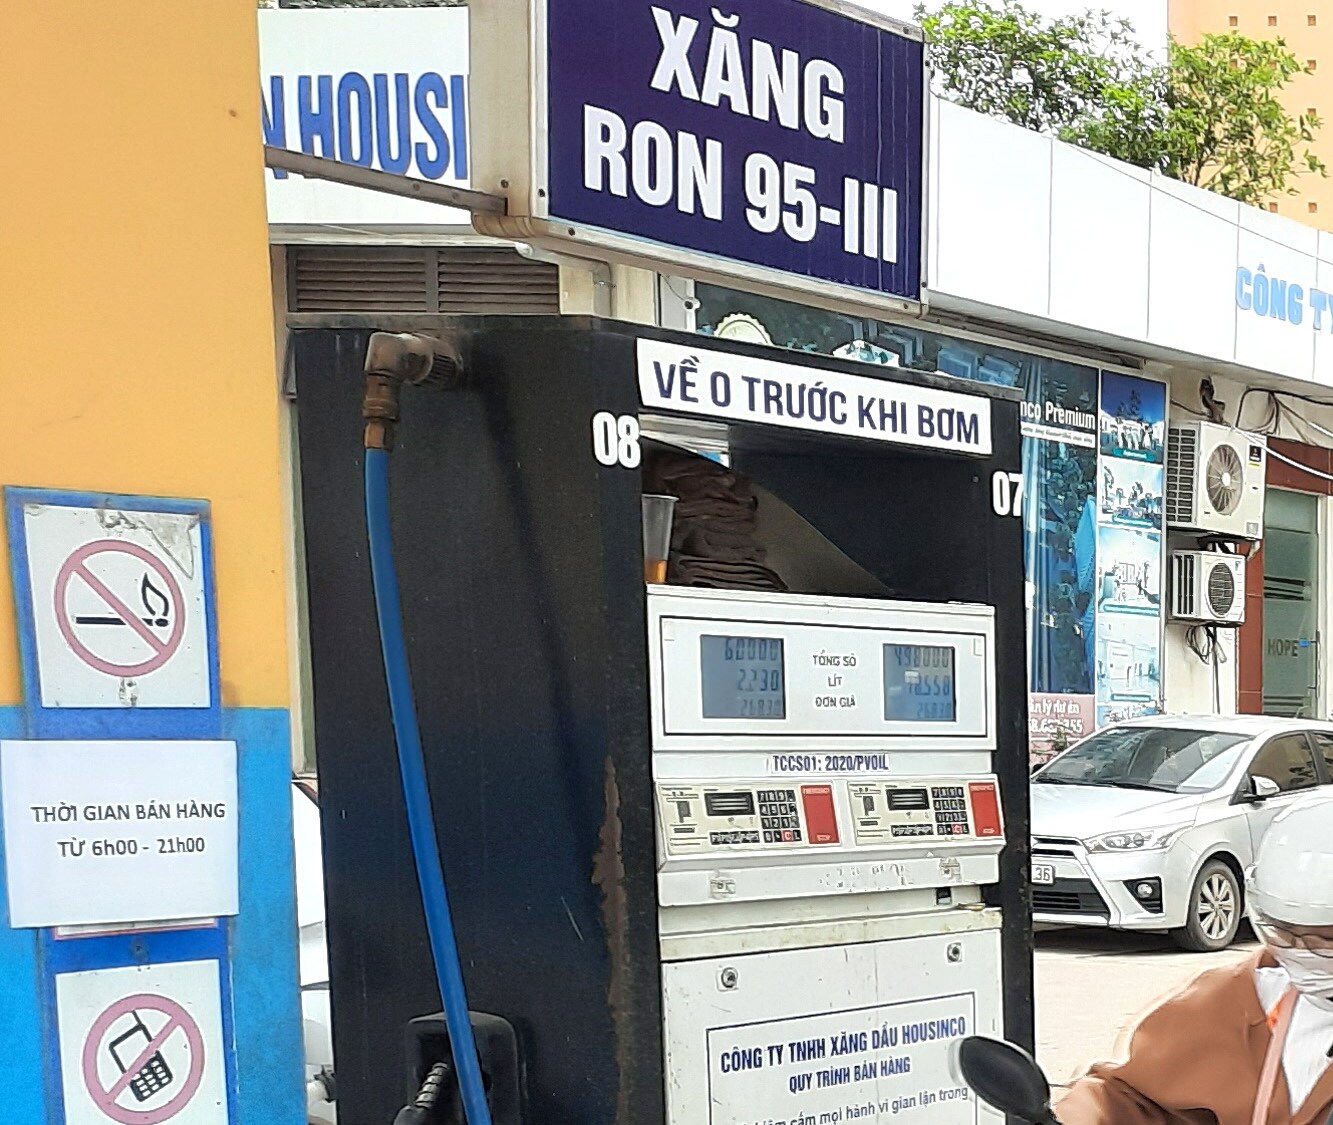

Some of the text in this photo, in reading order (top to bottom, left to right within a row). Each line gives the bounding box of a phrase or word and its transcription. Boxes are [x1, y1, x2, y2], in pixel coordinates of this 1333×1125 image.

[650, 8, 845, 145] XĂNG
[583, 104, 897, 264] RON 95-III
[1236, 264, 1303, 325] CÔNG
[653, 356, 700, 403] VỀ
[741, 376, 848, 425] TRƯỚC
[857, 395, 908, 434] KHI
[917, 404, 979, 445] BƠM
[1045, 401, 1096, 430] Premium
[594, 412, 641, 469] 08
[992, 471, 1023, 517] 07
[1267, 639, 1298, 657] HOPE
[30, 800, 225, 822] THỜI GIAN BÁN HÀNG
[57, 837, 205, 857] TỪ 6h00 21h00
[721, 1016, 966, 1073] CÔNG TY TNHH XĂNG DẦU HOUSINCO
[789, 1073, 813, 1094] QUY
[892, 1096, 916, 1114] gian
